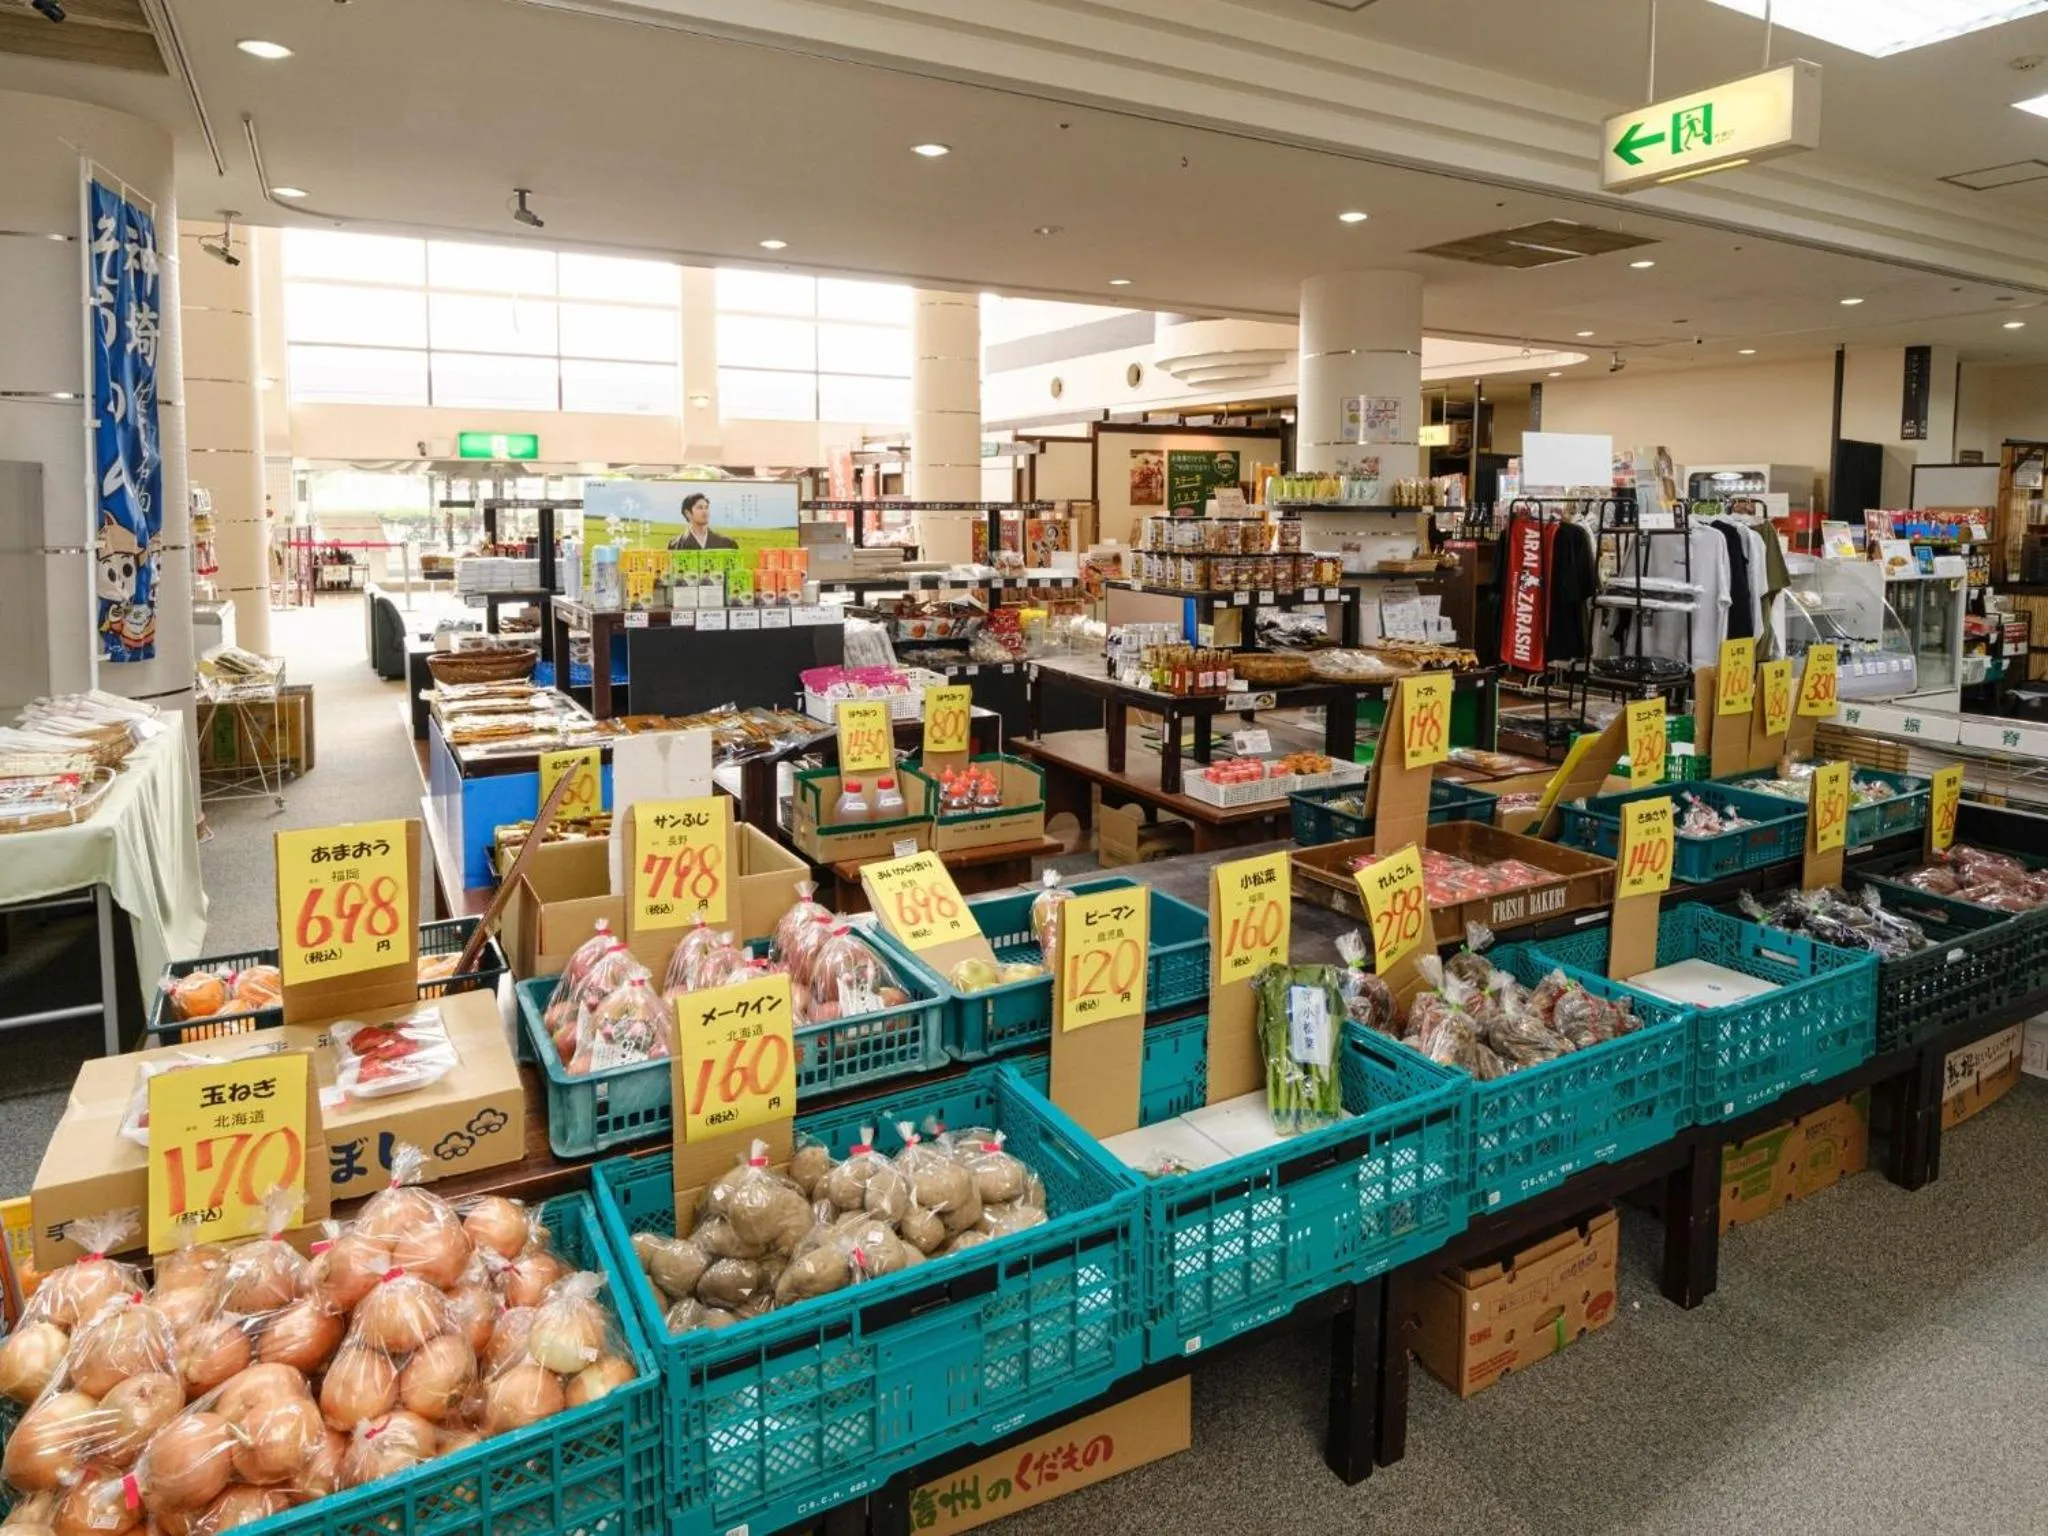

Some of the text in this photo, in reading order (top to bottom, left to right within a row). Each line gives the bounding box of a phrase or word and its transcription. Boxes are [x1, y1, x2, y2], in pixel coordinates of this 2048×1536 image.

[124, 224, 160, 367] 神埼
[1514, 527, 1541, 661] ARAI ZARASHI
[1417, 686, 1436, 698] トマト
[929, 708, 966, 738] 800
[846, 729, 885, 756] 1450
[653, 812, 710, 829] サンふじ
[311, 839, 391, 864] あまおう
[1626, 838, 1669, 877] 140
[332, 868, 360, 882] 福岡
[643, 844, 722, 899] 798
[1241, 868, 1277, 890] 小松菜
[1377, 863, 1414, 889] れんこん
[296, 875, 399, 948] 698
[698, 899, 709, 910] 円
[895, 882, 958, 926] 698
[1085, 905, 1135, 926] ピーマン
[1493, 886, 1567, 924] FRESH BAKERY
[1225, 900, 1284, 957] 160
[1375, 885, 1423, 953] 298
[304, 949, 343, 964] (税込)
[376, 939, 391, 952] 円
[1068, 939, 1141, 1002] 120
[701, 995, 782, 1026] メークイン
[726, 1024, 764, 1042] 北海道
[688, 1034, 789, 1115] 160
[200, 1078, 277, 1109] 玉ねぎ
[768, 1096, 781, 1110] 円
[213, 1109, 266, 1128] 北海道
[705, 1107, 740, 1126] (税込)
[164, 1127, 301, 1217] 170
